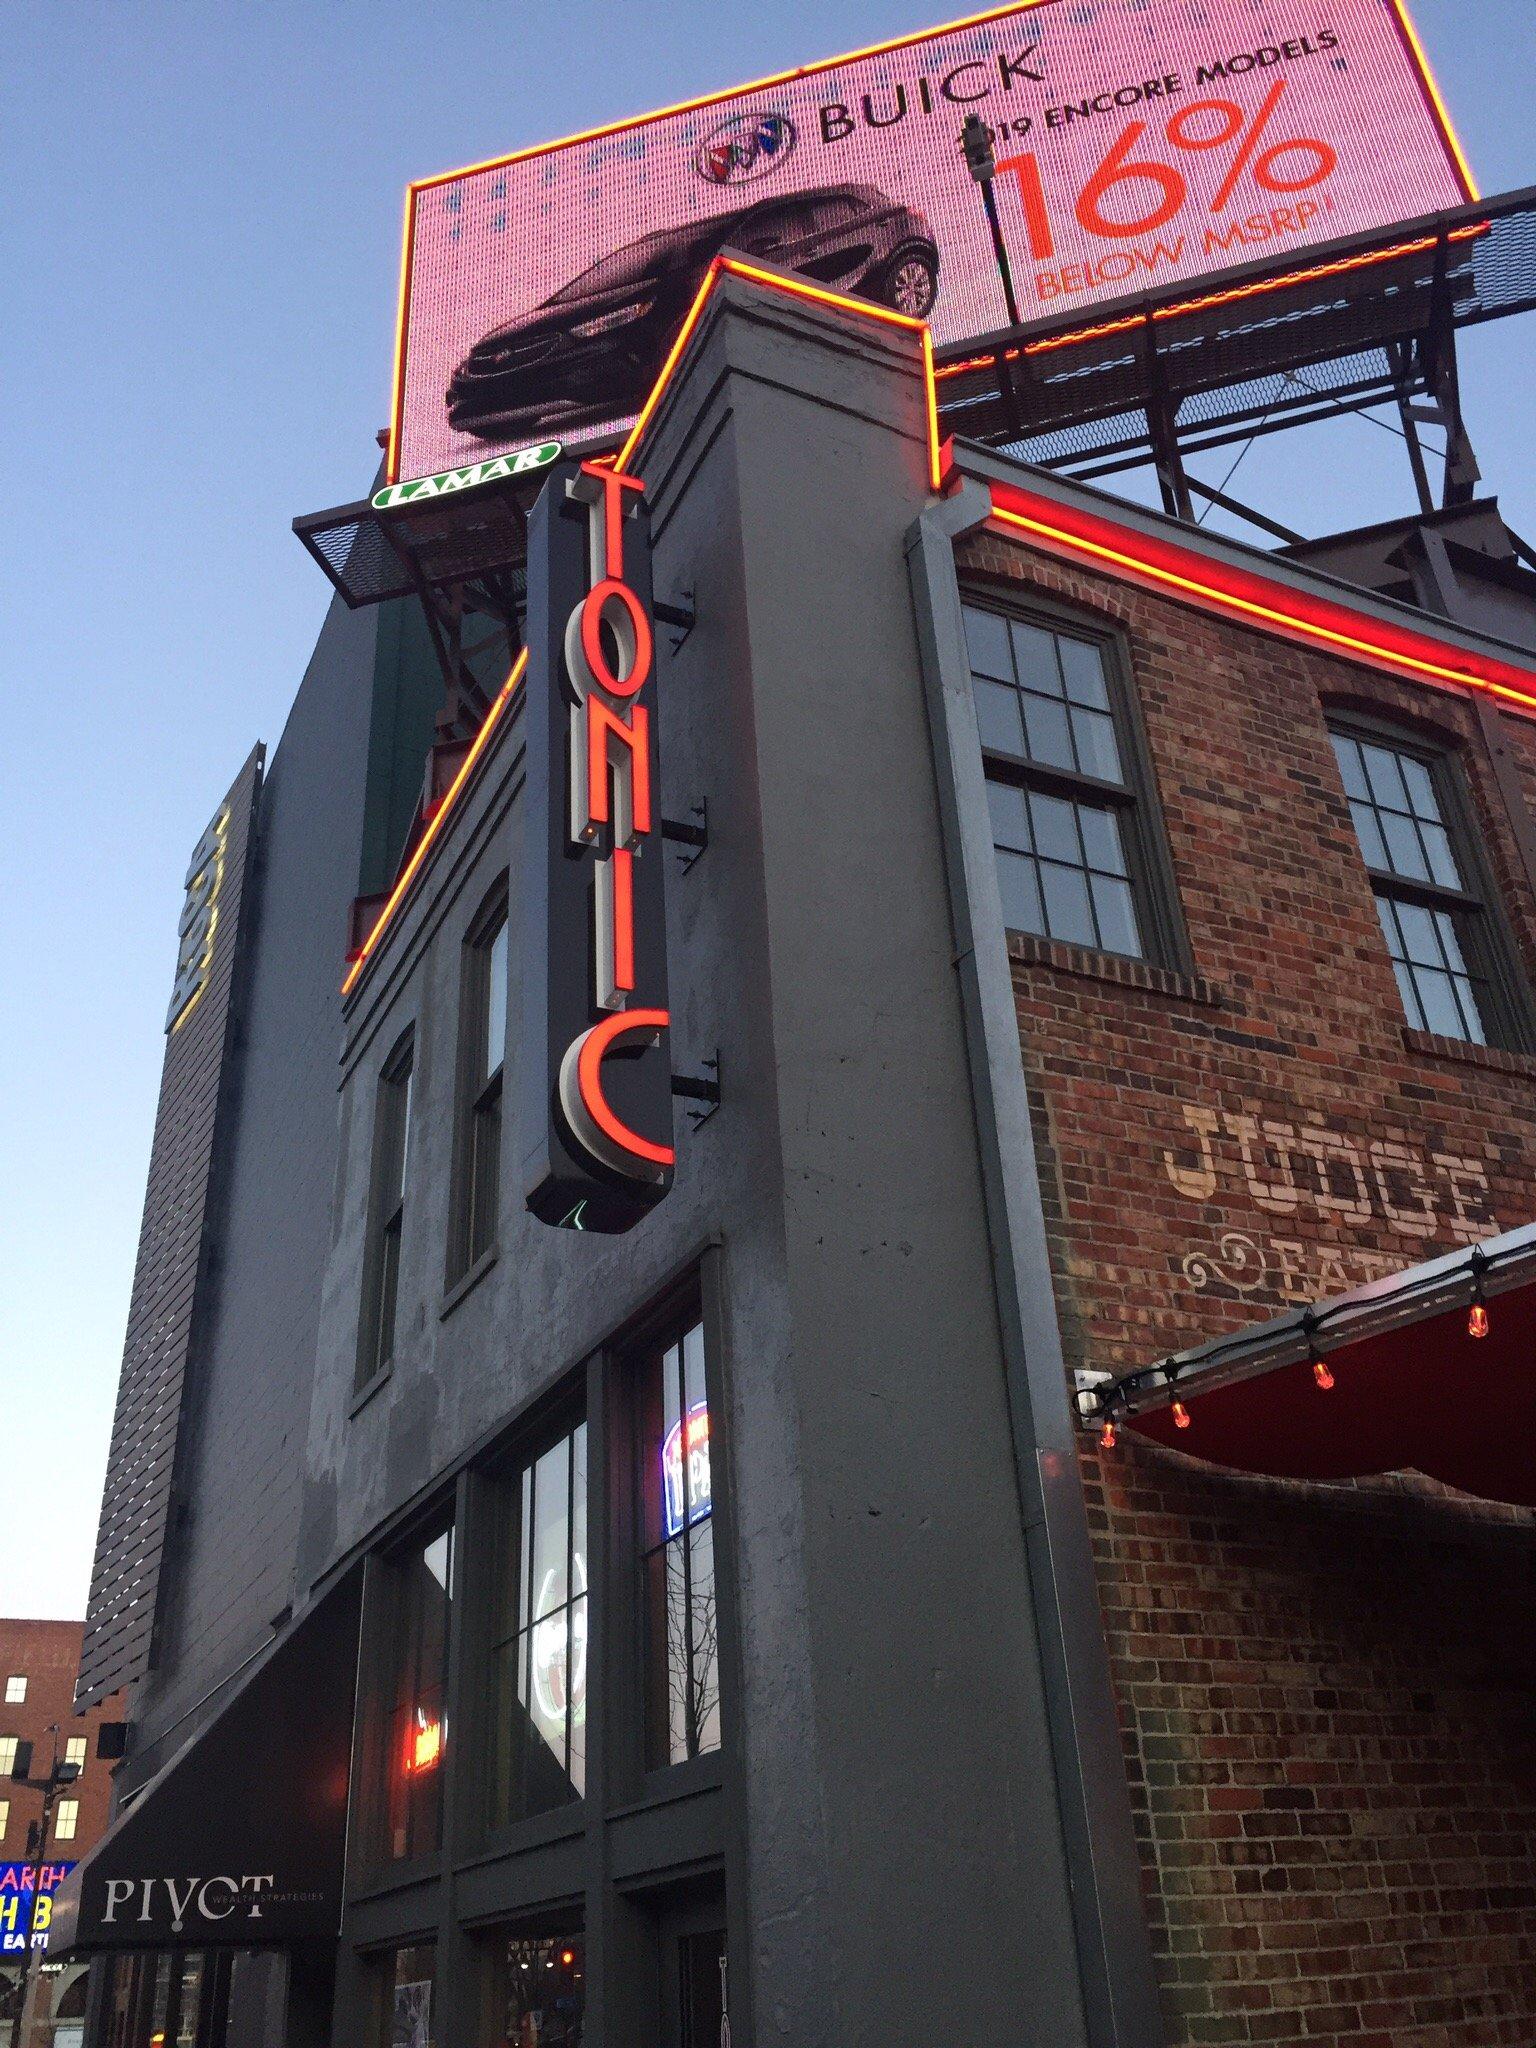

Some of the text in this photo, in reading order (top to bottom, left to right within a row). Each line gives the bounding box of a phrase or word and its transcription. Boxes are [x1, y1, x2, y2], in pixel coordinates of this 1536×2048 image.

[819, 44, 1045, 144] BUICK
[1044, 73, 1182, 129] ENCORE
[1196, 29, 1338, 85] MODELS
[995, 79, 1338, 261] 16%
[1034, 233, 1185, 301] BELOW
[387, 447, 543, 506] LAMAR
[567, 461, 676, 1168] TONIC
[1163, 1104, 1501, 1244] JUDGE
